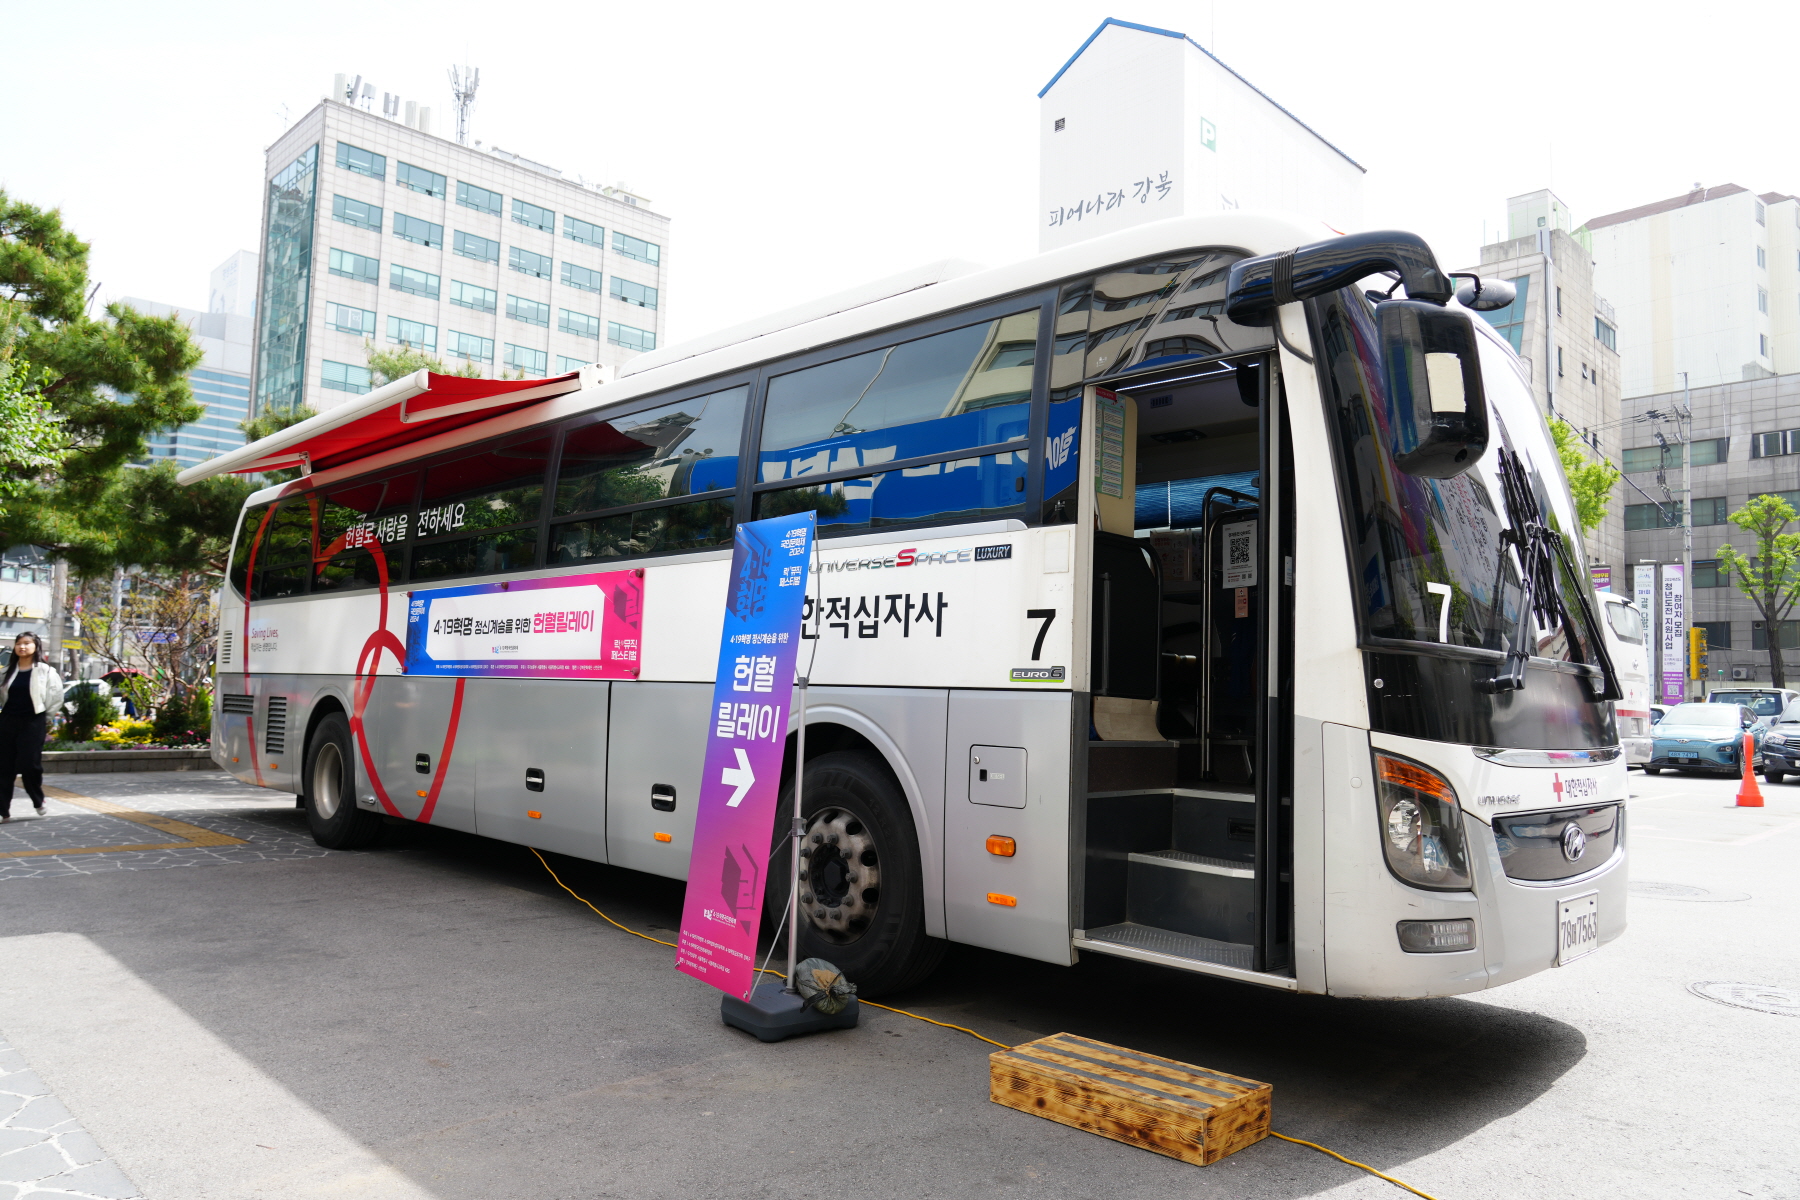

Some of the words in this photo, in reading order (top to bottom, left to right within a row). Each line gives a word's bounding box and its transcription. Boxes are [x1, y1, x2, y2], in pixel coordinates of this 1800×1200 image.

[1049, 189, 1126, 227] 피어나라
[1132, 170, 1174, 205] 강북
[345, 521, 375, 550] 헌혈로
[375, 514, 408, 543] 사랑을
[417, 503, 466, 537] 전하세요
[788, 546, 805, 557] 2024
[976, 545, 1011, 560] LUXURY
[1427, 581, 1452, 643] 7
[1664, 582, 1673, 616] 청년도전
[1673, 594, 1683, 619] 참여자
[474, 618, 513, 635] 정신계승을
[514, 617, 532, 634] 위한
[532, 609, 594, 634] 헌혈릴레이
[1026, 608, 1057, 661] 7
[1664, 617, 1673, 650] 지원사업
[1673, 621, 1683, 638] 모집
[751, 633, 778, 645] 정신계승을
[778, 632, 790, 644] 위한
[611, 650, 637, 661] 페스티벌
[732, 654, 777, 693] 헌혈
[716, 701, 781, 743] 릴레이
[1564, 777, 1598, 799] 대한적십자사
